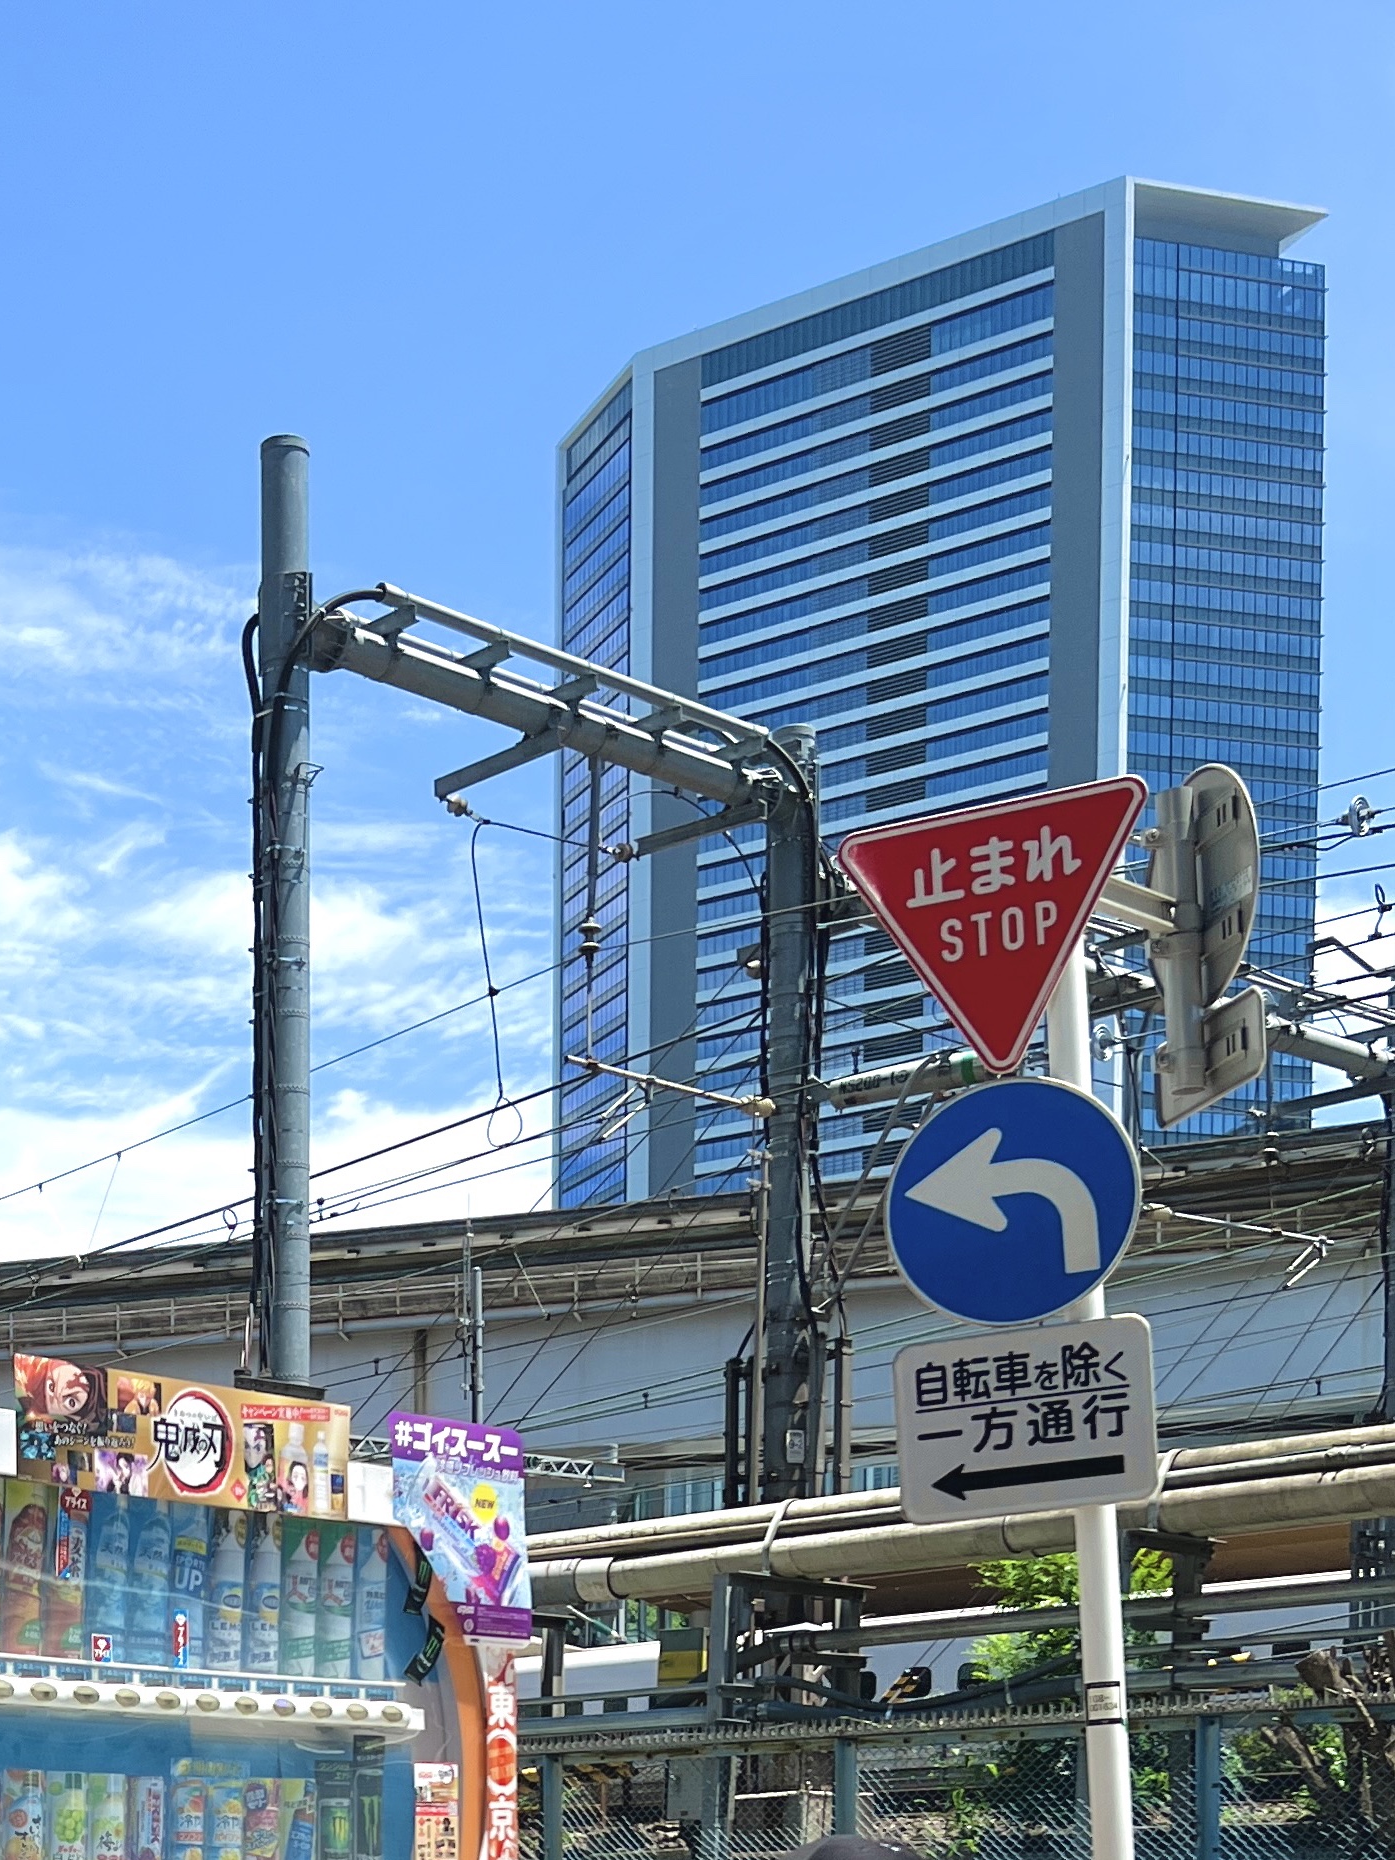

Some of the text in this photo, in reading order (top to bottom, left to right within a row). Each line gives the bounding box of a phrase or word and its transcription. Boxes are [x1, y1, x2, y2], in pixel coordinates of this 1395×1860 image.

[907, 825, 1081, 908] 止まれ
[940, 900, 1058, 962] STOP
[916, 1341, 1127, 1407] 自転車を除く
[147, 1417, 226, 1471] 鬼滅の刃
[395, 1420, 519, 1463] #ゴイスースー
[917, 1393, 1130, 1453] 一方通行
[475, 1498, 494, 1509] NEW
[174, 1567, 204, 1592] UP
